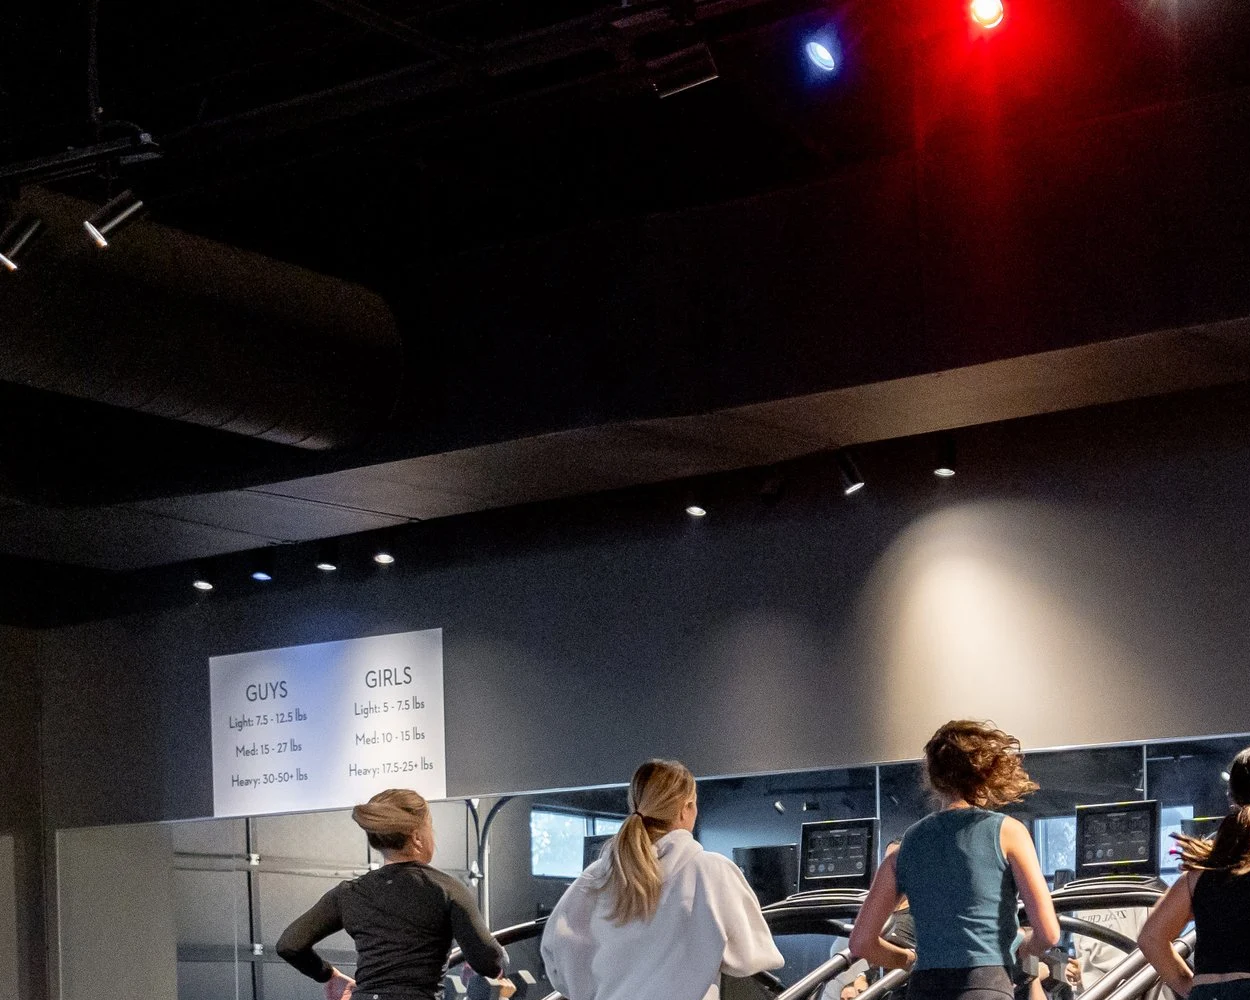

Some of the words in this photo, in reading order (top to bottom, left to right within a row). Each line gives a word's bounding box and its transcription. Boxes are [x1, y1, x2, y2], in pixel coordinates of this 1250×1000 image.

[365, 666, 412, 688] GIRLS
[246, 680, 288, 702] GUYS
[354, 700, 381, 718] Light:
[383, 702, 389, 712] 5
[397, 699, 410, 711] 7.5
[412, 695, 425, 710] lbs
[229, 713, 254, 732] Light:
[255, 715, 268, 726] 7.5
[276, 712, 293, 723] 12.5
[295, 707, 308, 721] lbs
[355, 730, 380, 746] Med:
[382, 732, 393, 743] 10
[400, 730, 411, 742] 15
[412, 726, 426, 740] lbs
[235, 742, 259, 757] Med:
[260, 744, 270, 755] 15
[277, 742, 288, 753] 27
[290, 738, 303, 752] lbs
[231, 774, 261, 789] Heavy:
[262, 772, 294, 784] 30-50+
[295, 767, 309, 781] lbs
[348, 763, 380, 779] Heavy:
[420, 756, 434, 771] lbs
